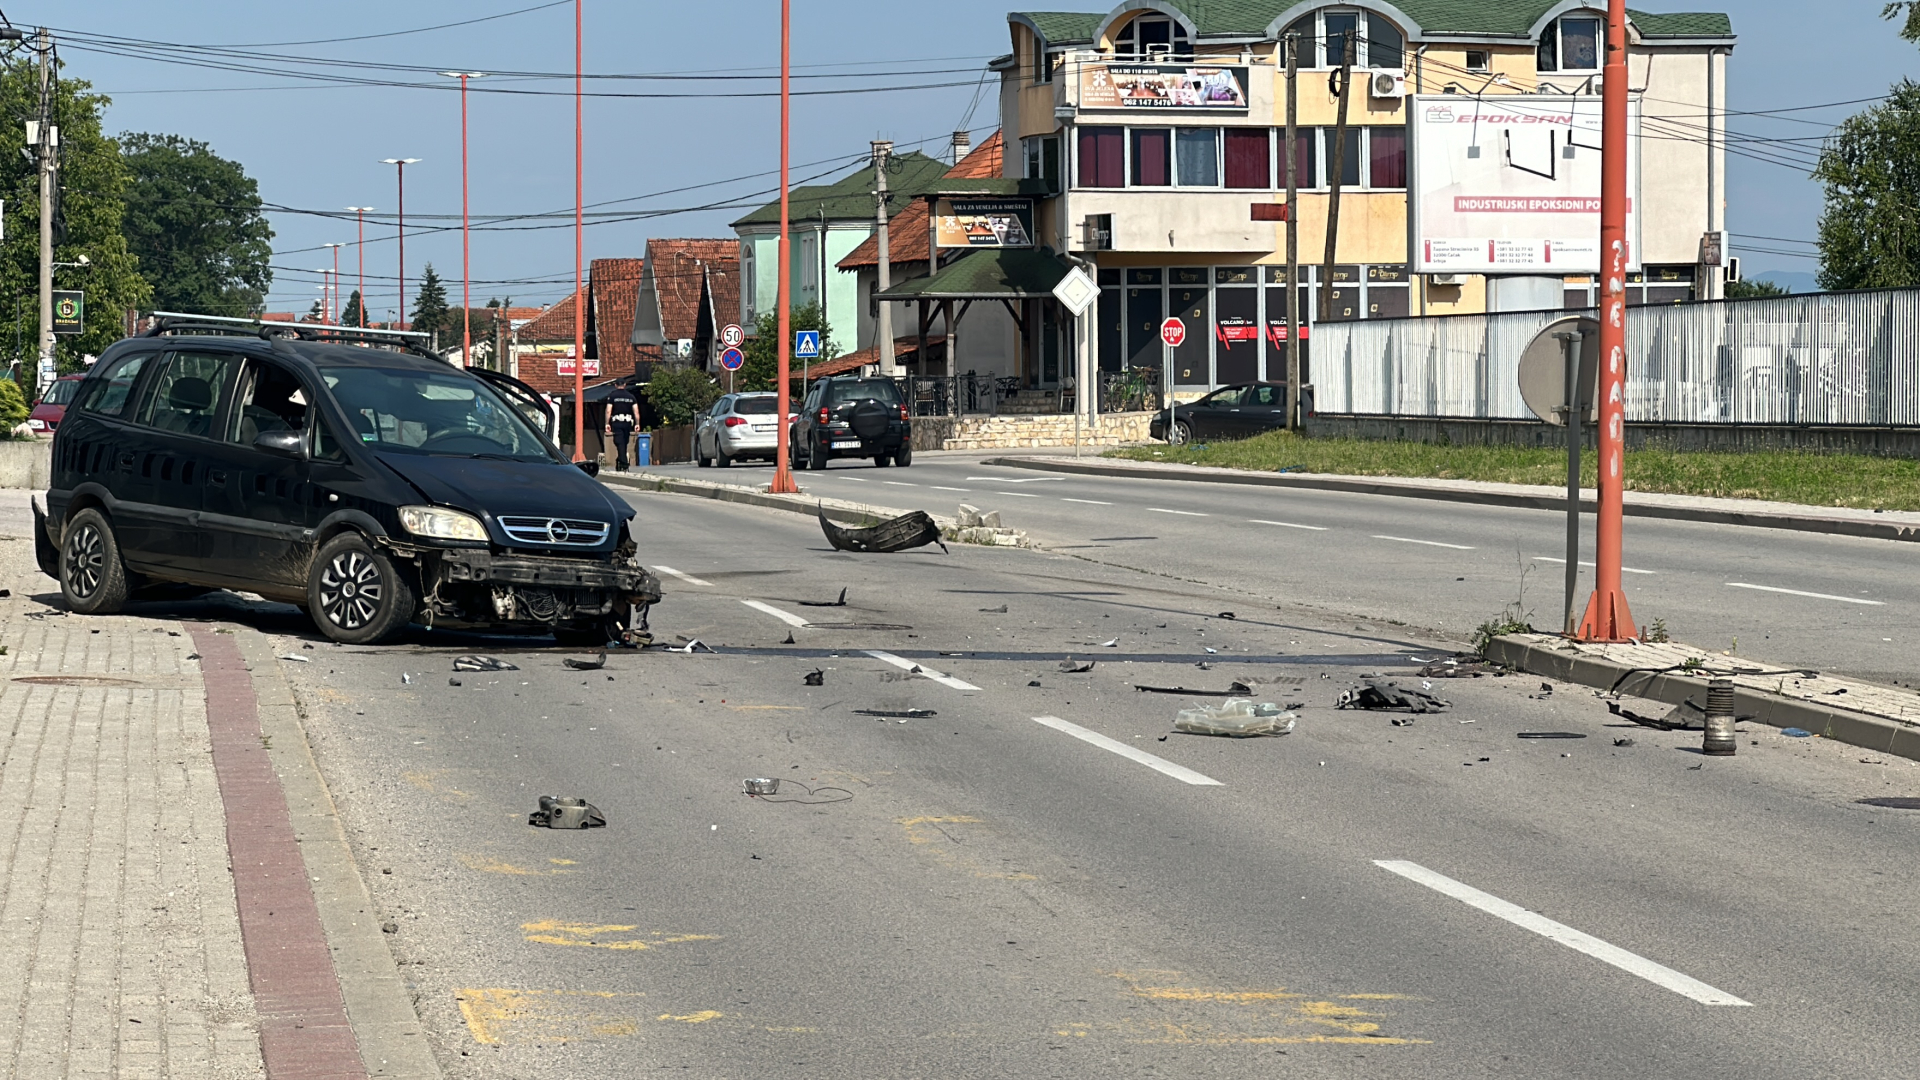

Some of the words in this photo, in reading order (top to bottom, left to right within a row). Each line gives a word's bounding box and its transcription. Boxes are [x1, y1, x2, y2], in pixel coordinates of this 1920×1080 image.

[1456, 114, 1572, 124] EPOKSAN
[1458, 199, 1527, 210] INDUSTRIJSKI
[1529, 200, 1584, 210] EPOKSIDNI
[1585, 201, 1601, 210] PO
[726, 330, 740, 342] 50
[1164, 327, 1183, 337] STOP
